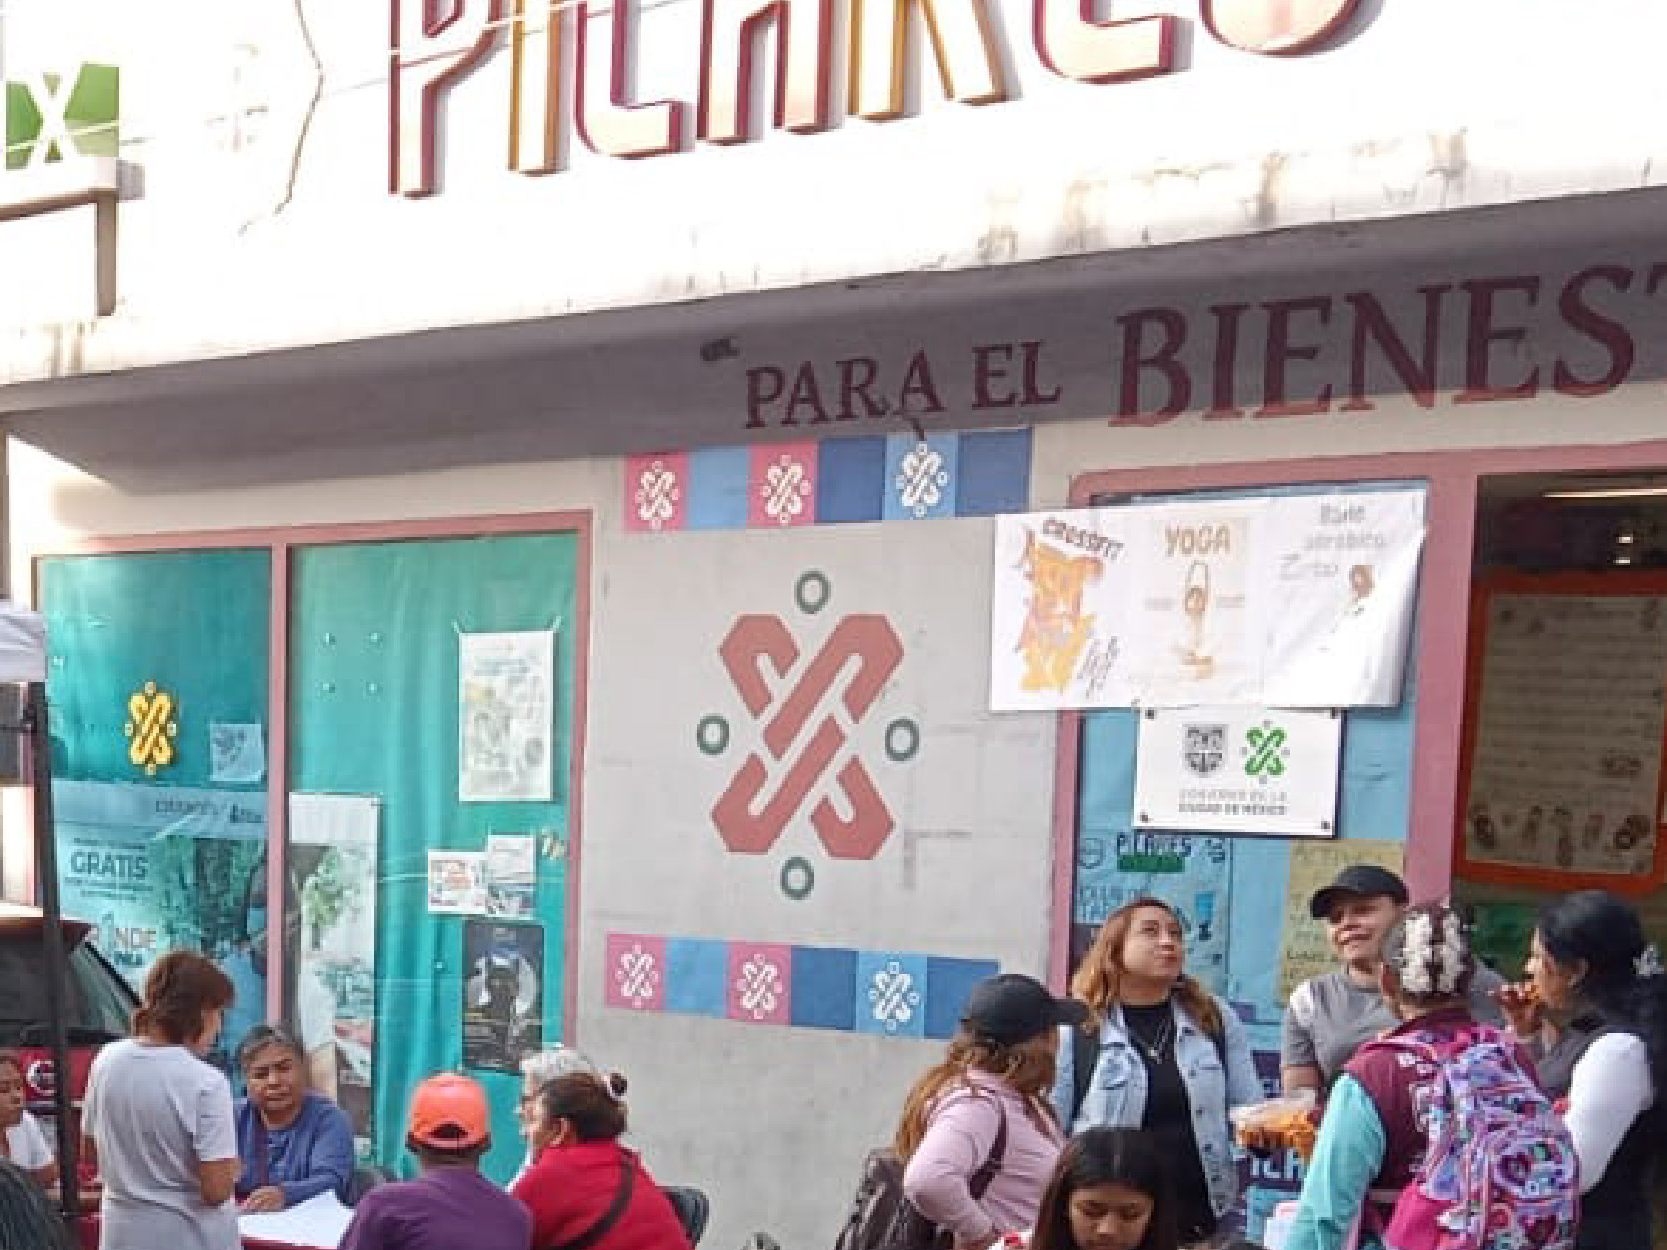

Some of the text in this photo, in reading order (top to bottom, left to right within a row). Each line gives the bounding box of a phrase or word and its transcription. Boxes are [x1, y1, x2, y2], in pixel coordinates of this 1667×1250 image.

[745, 347, 947, 430] PARA
[971, 338, 1063, 410] EL
[70, 850, 149, 880] GRATIS
